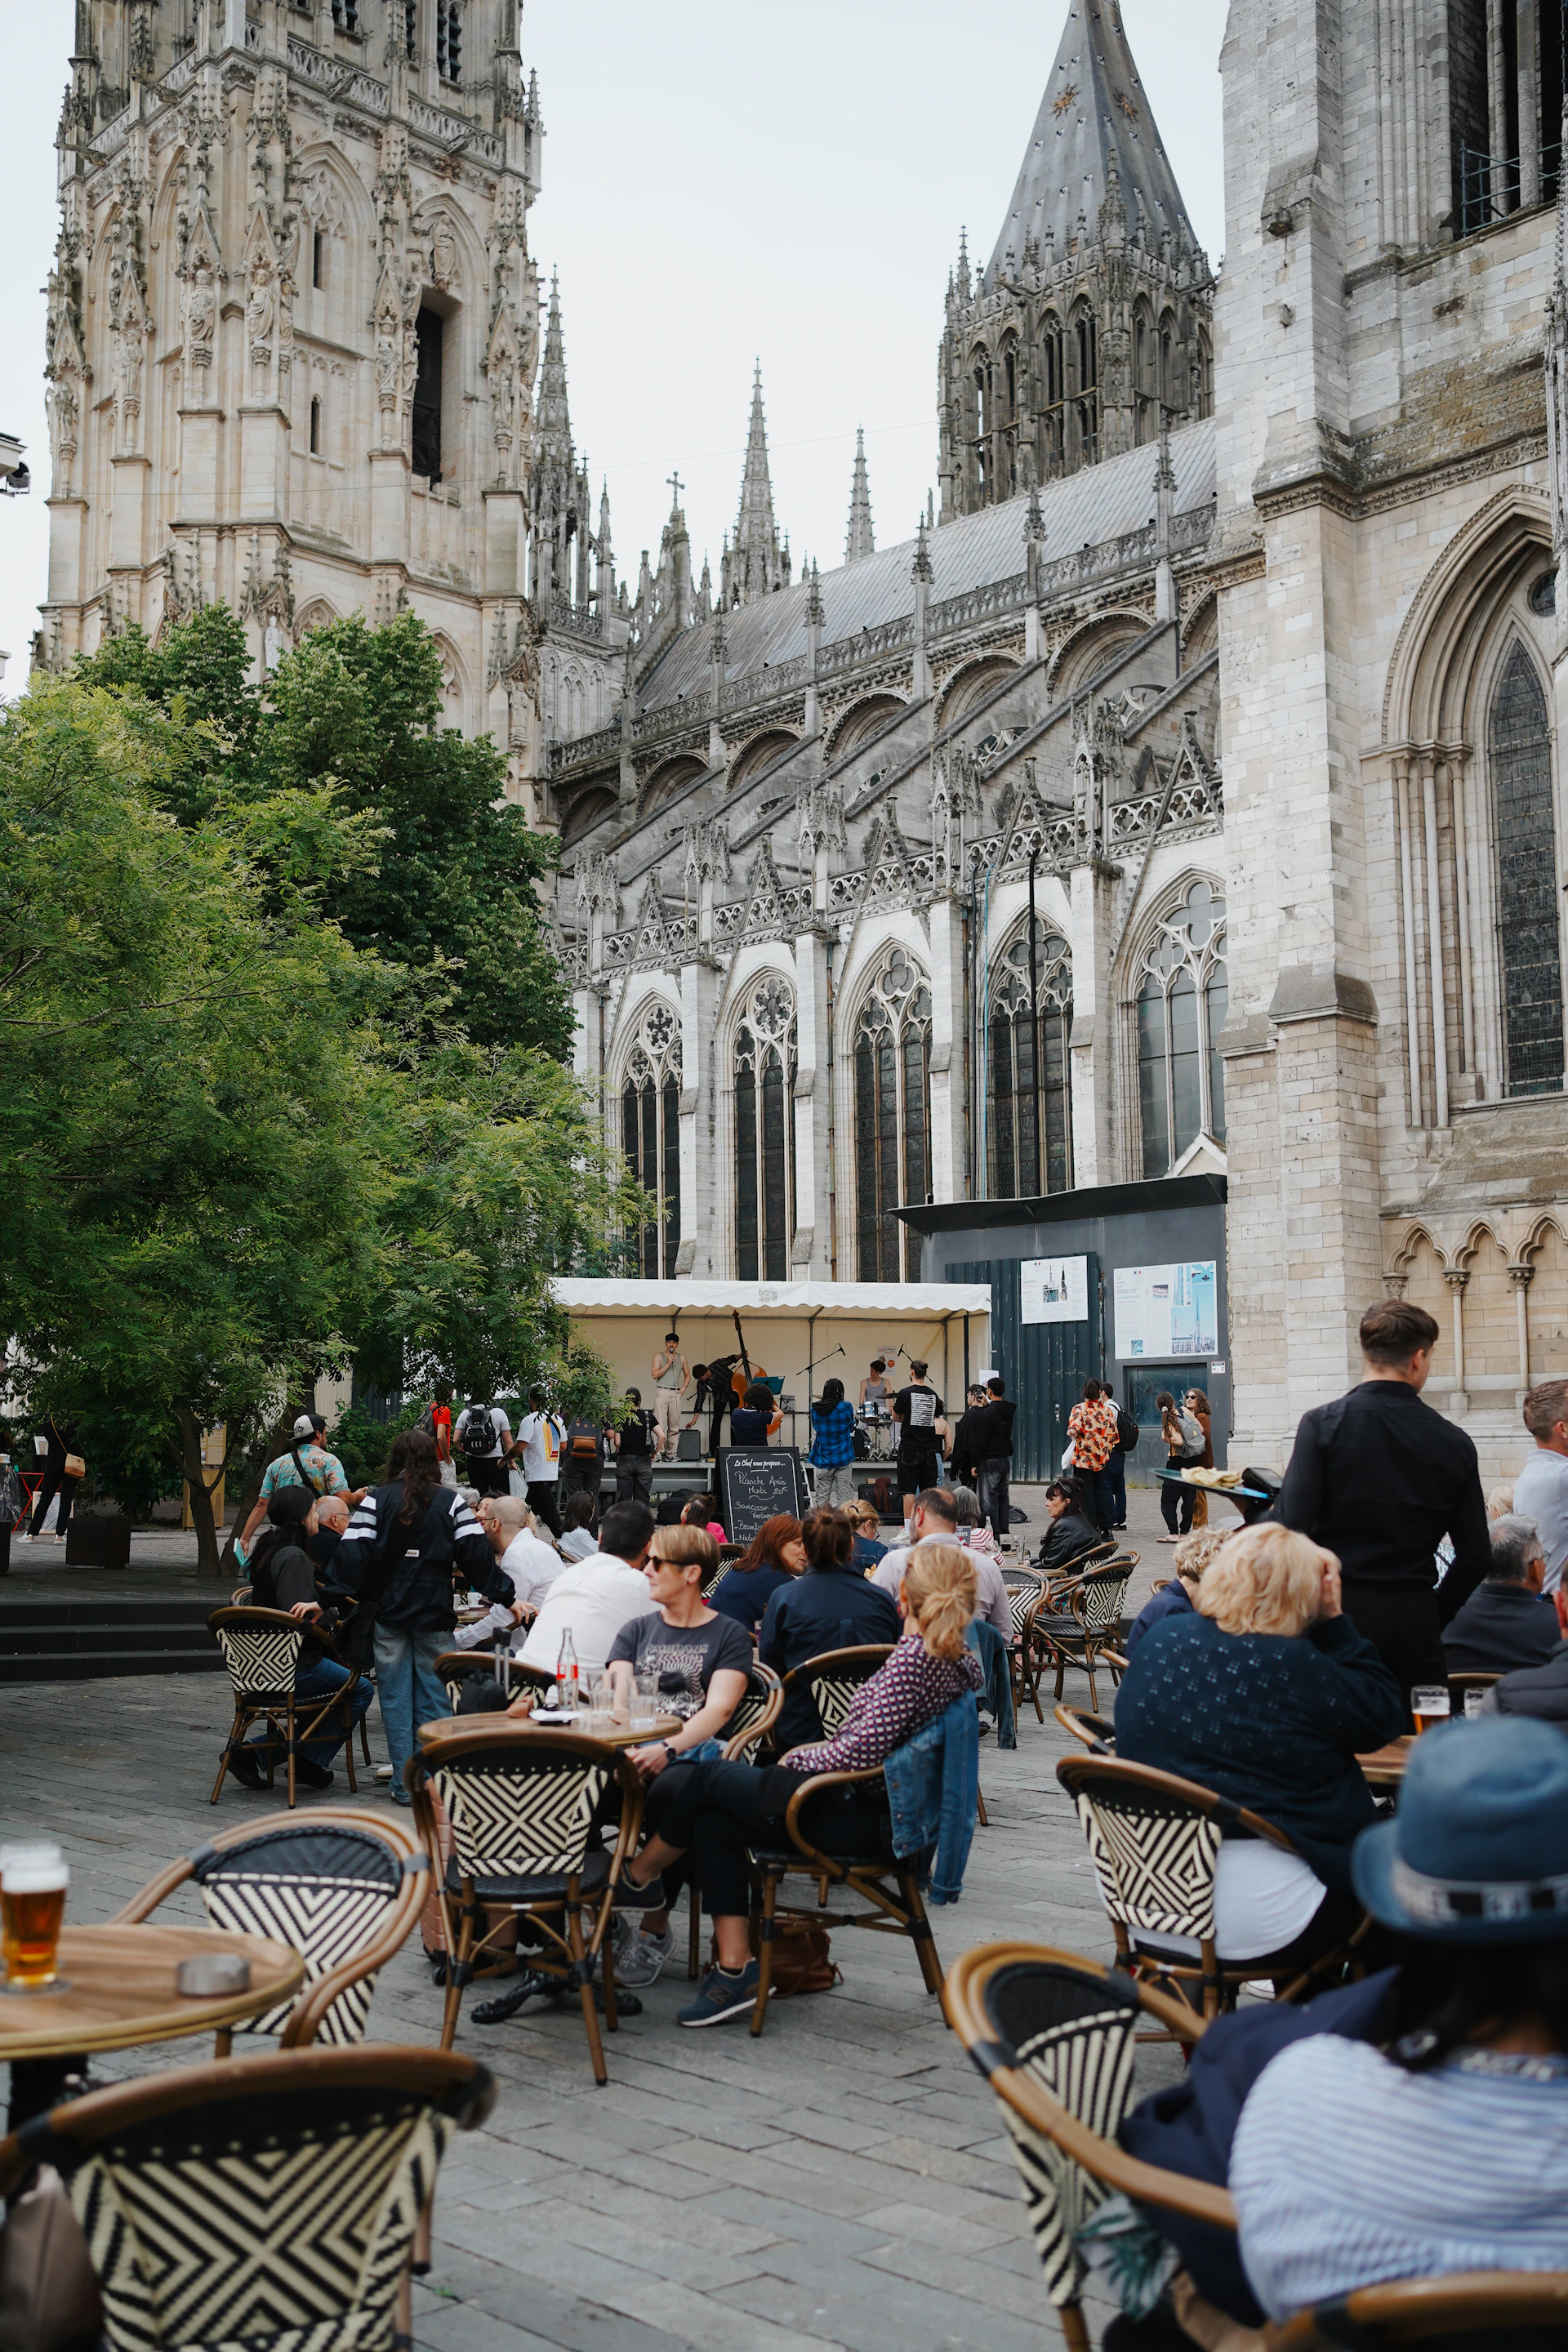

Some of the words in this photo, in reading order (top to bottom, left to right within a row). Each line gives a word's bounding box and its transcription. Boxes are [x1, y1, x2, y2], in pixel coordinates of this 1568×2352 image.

[742, 1459, 753, 1468] Chef
[735, 1471, 764, 1485] Planche
[768, 1475, 786, 1487] Apéro
[734, 1501, 769, 1511] Saucisson
